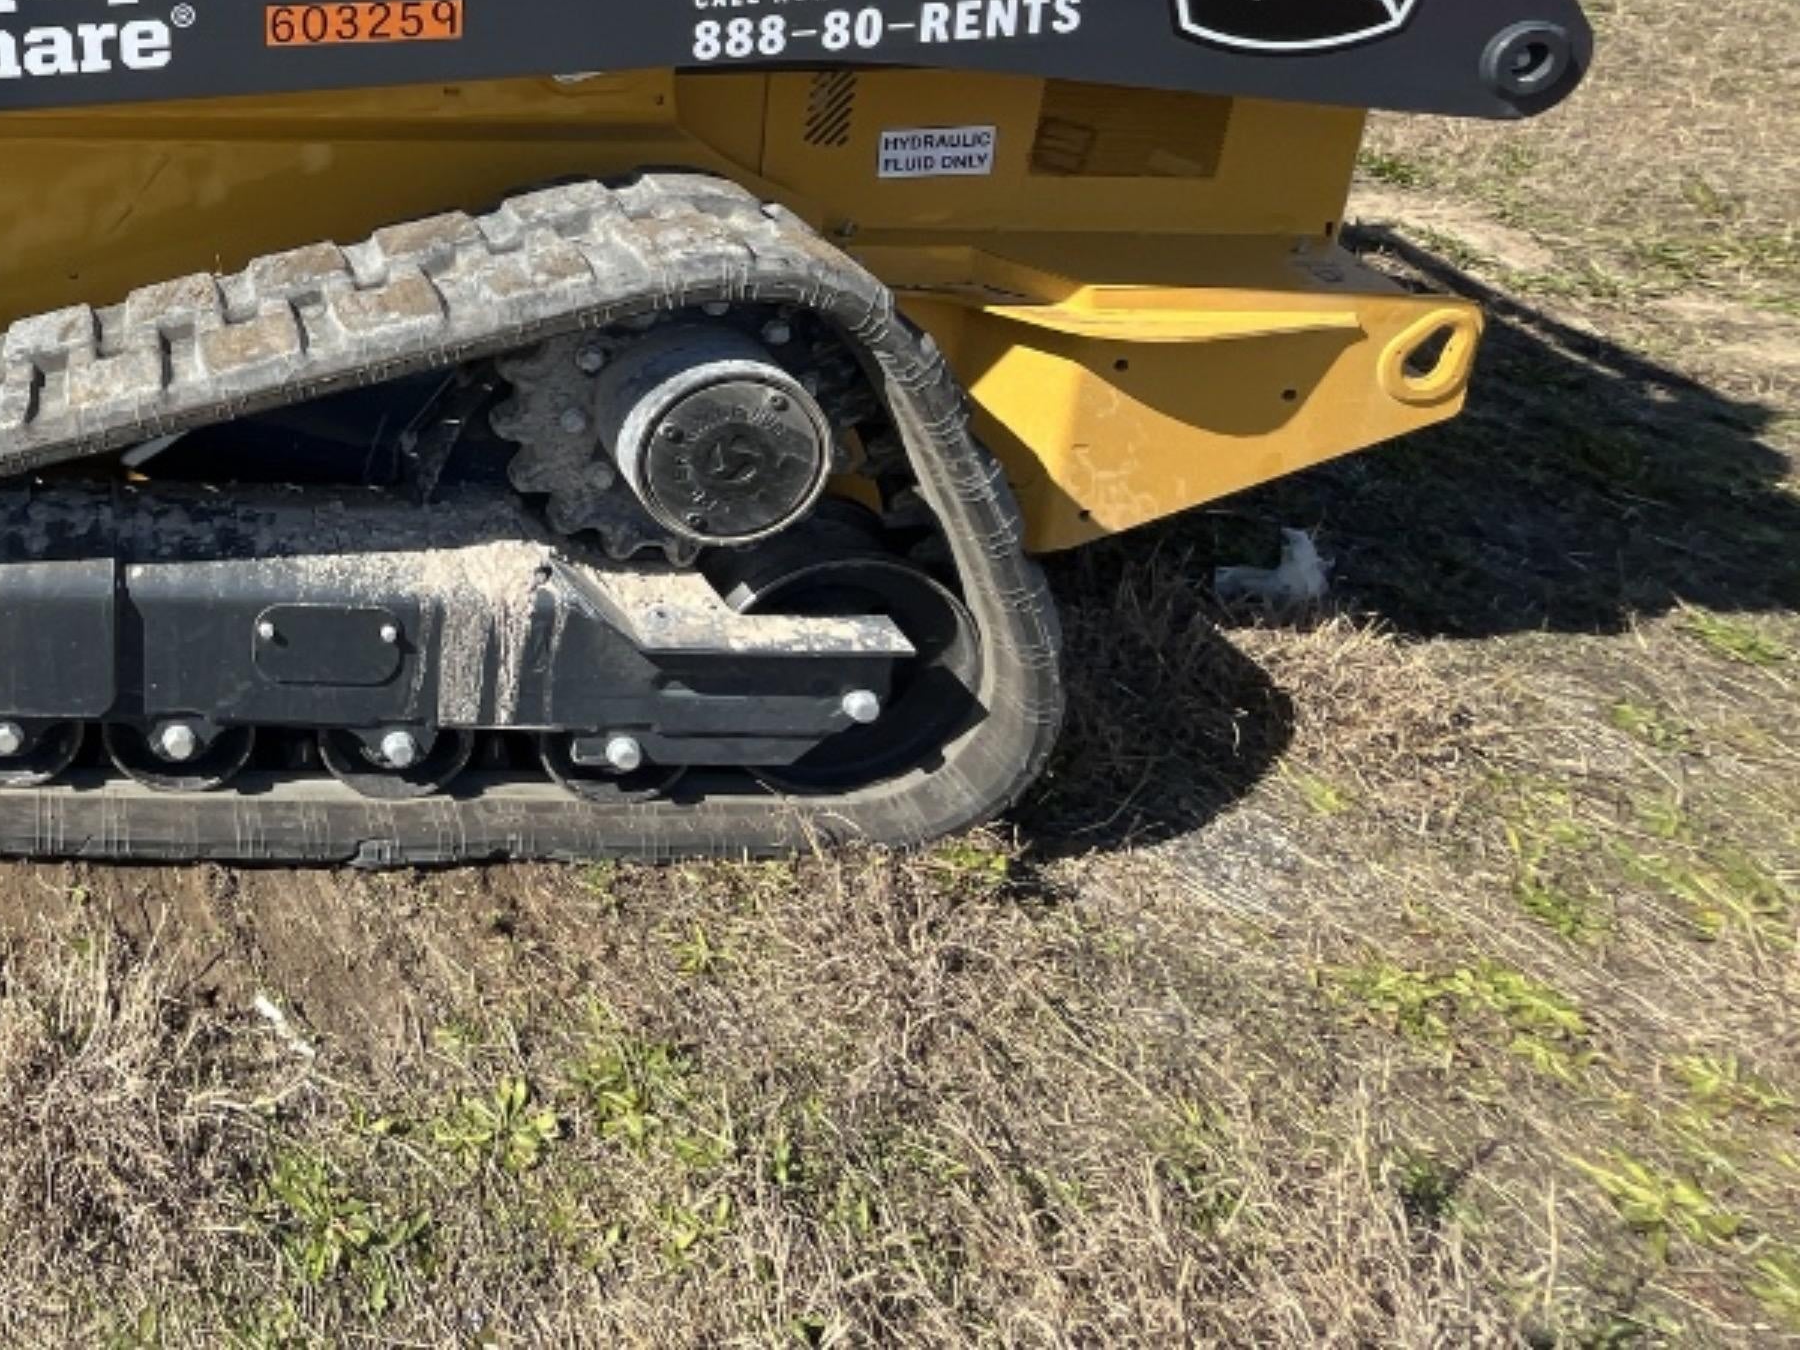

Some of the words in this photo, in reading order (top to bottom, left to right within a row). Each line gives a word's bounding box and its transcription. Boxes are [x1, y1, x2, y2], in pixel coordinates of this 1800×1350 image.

[270, 0, 458, 43] 603259
[883, 131, 992, 151] HYDRAULIC
[883, 155, 935, 172] FLUID
[941, 152, 989, 169] ONLY
